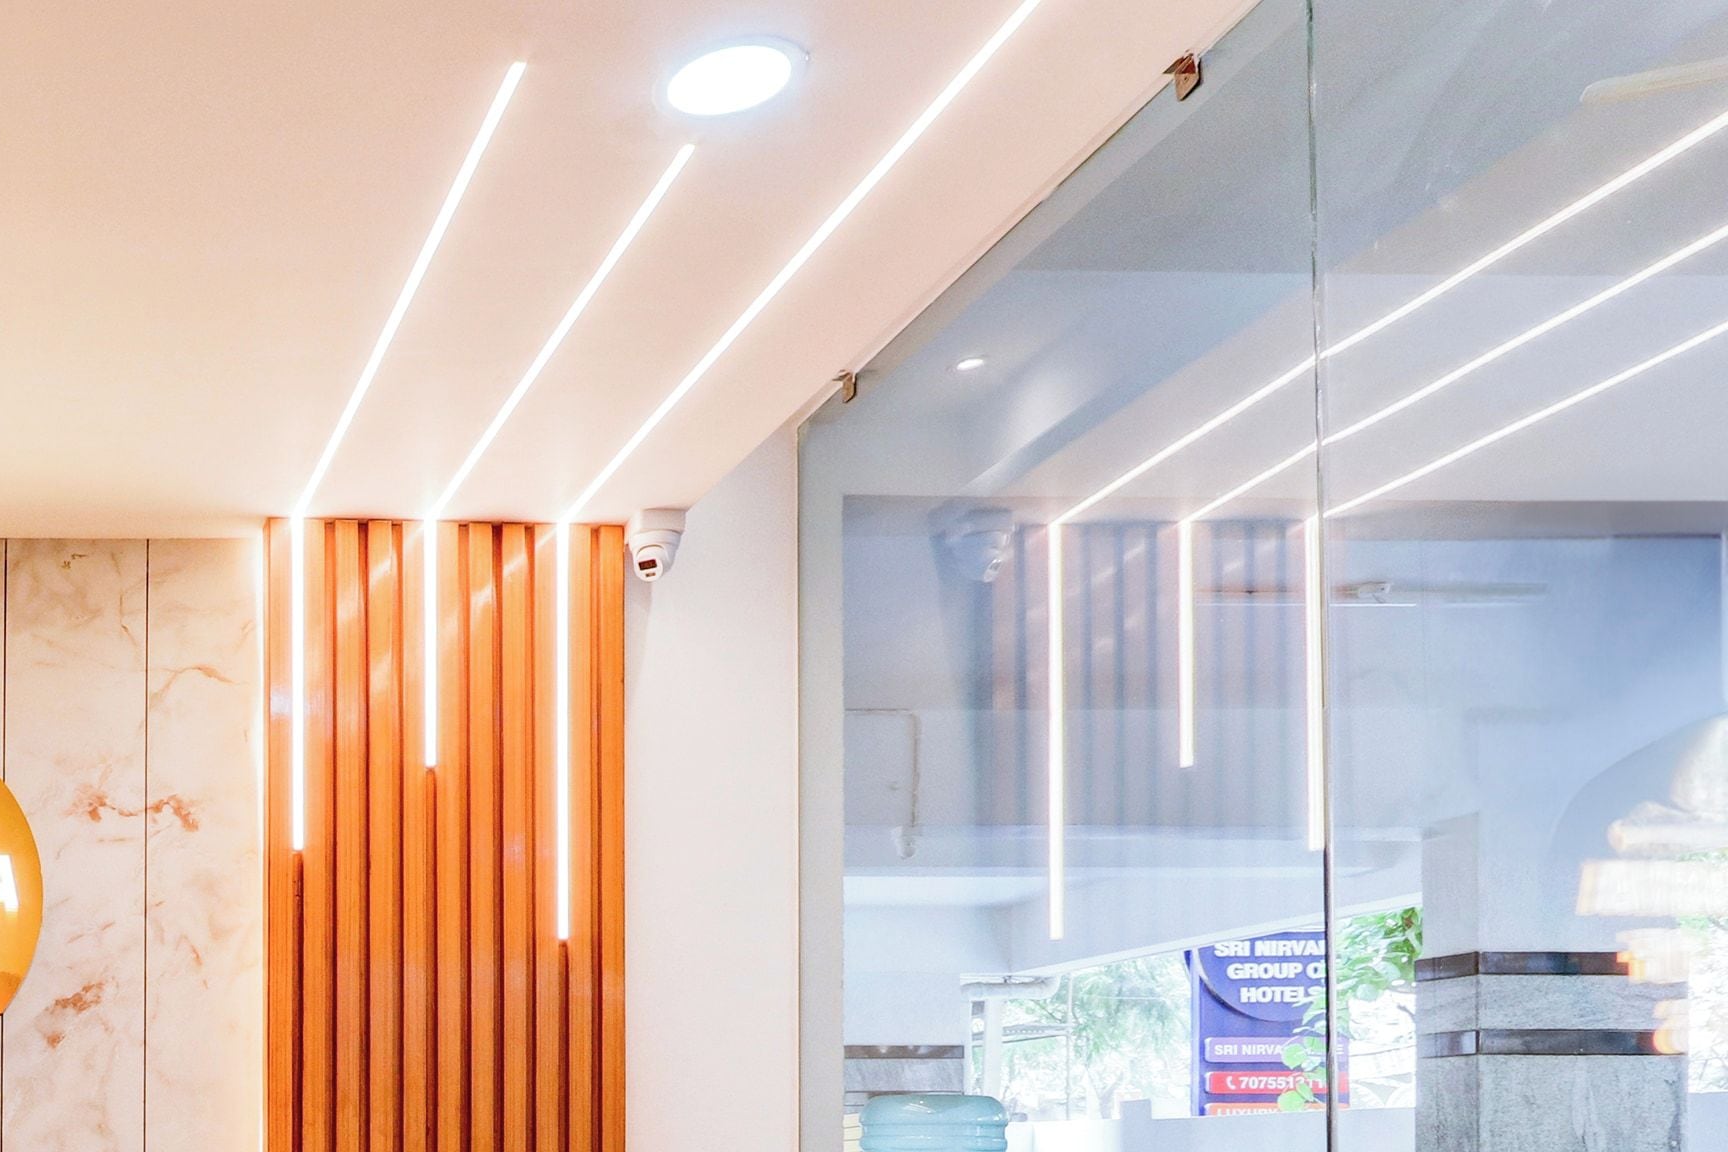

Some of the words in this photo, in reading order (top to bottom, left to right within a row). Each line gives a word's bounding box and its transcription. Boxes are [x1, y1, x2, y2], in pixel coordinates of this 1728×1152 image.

[1214, 940, 1251, 958] SRI
[1254, 939, 1326, 957] NIRVA
[1226, 962, 1304, 980] GROUP
[1214, 1044, 1238, 1056] SRI
[1241, 1044, 1282, 1056] NIRVA
